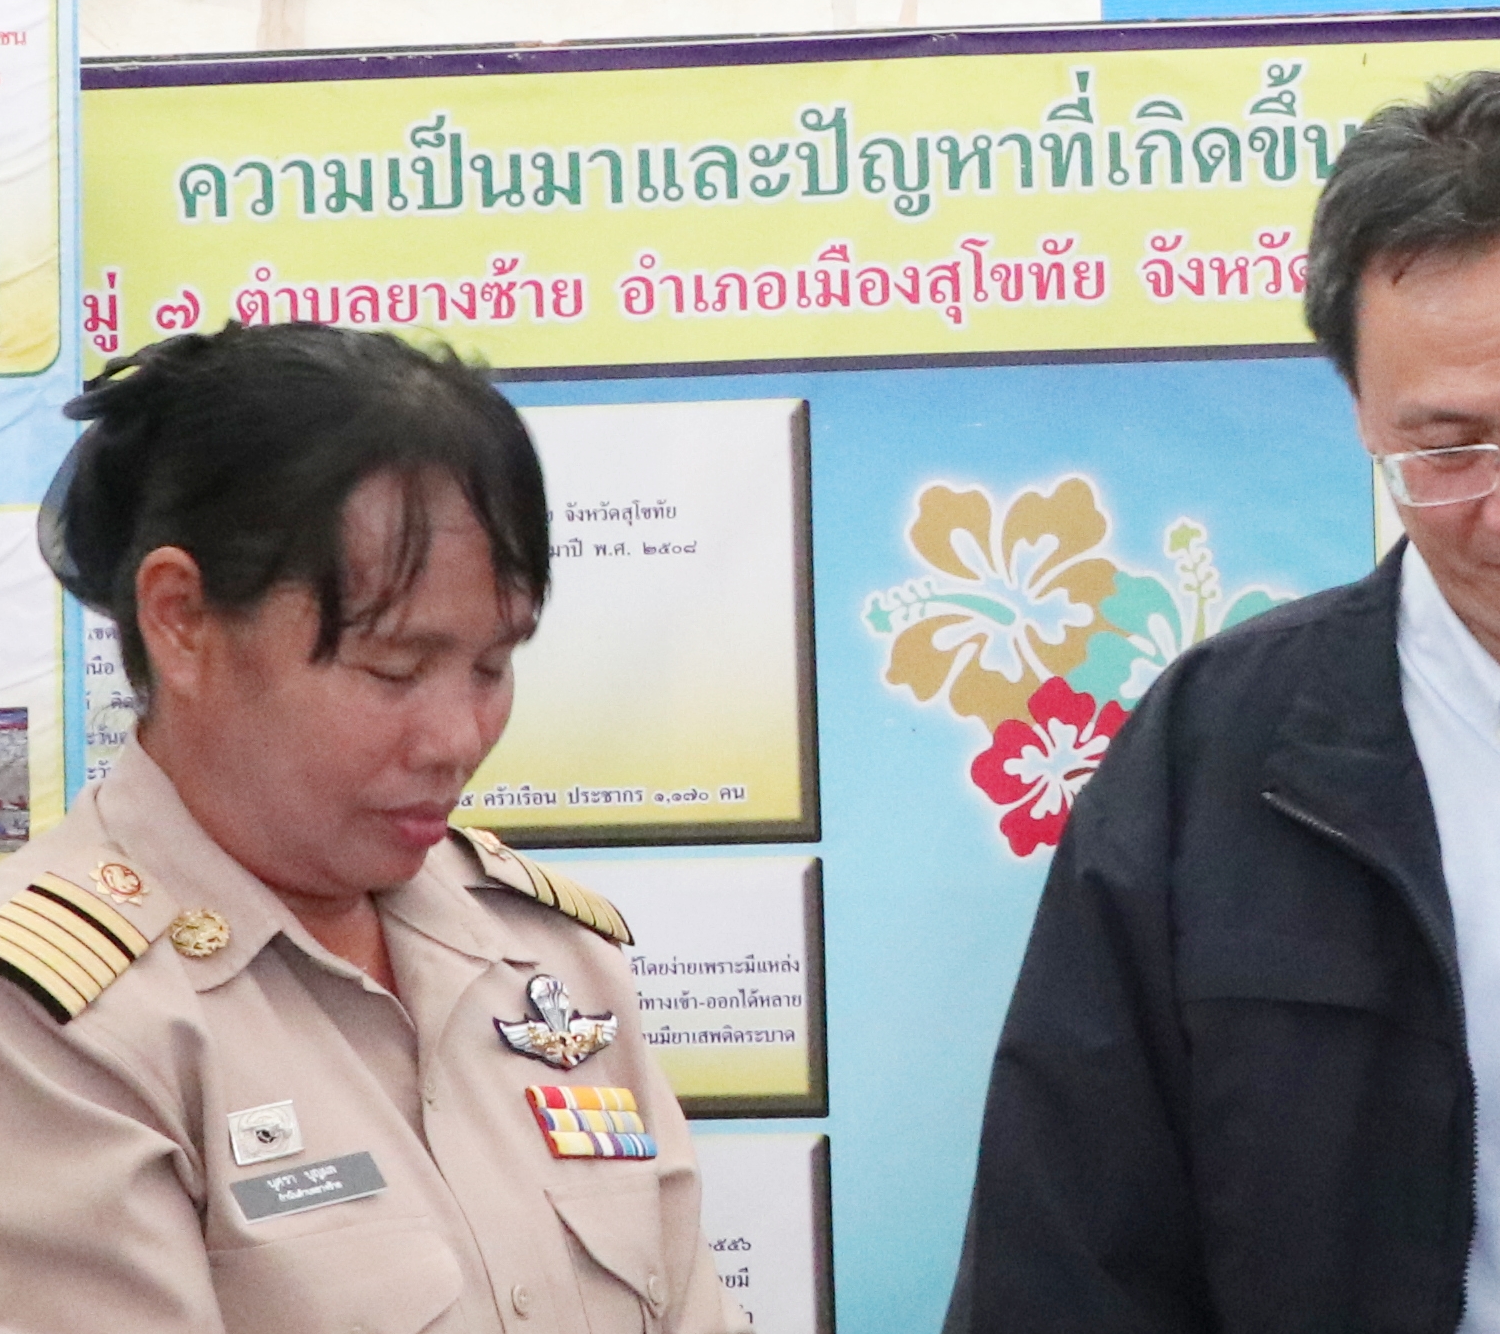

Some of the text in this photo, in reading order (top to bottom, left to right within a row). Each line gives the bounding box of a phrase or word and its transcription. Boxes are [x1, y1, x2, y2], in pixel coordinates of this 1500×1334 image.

[178, 63, 1362, 225] ความเป็นมาและปัญหาที่เกิดขึ้น
[83, 272, 119, 354] มู่
[156, 290, 201, 331] ๗
[235, 258, 585, 328] ตำบลยางซ้าย
[620, 237, 1106, 337] อำเภอเมืองสุโขทัย
[564, 499, 677, 526] จังหวัดสุโขทัย
[548, 538, 698, 559] มาปี พ.ศ. ๒๕๐๘
[483, 784, 557, 806] ครัวเรือน
[567, 784, 644, 805] ประชากร
[720, 785, 745, 801] คน
[630, 954, 800, 976] ด้โดยง่ายเพราะมีแหล่ง
[638, 988, 802, 1010] ีทางเข้า-ออกได้หลาย
[642, 1025, 796, 1046] นมียาเสพติดระบาด
